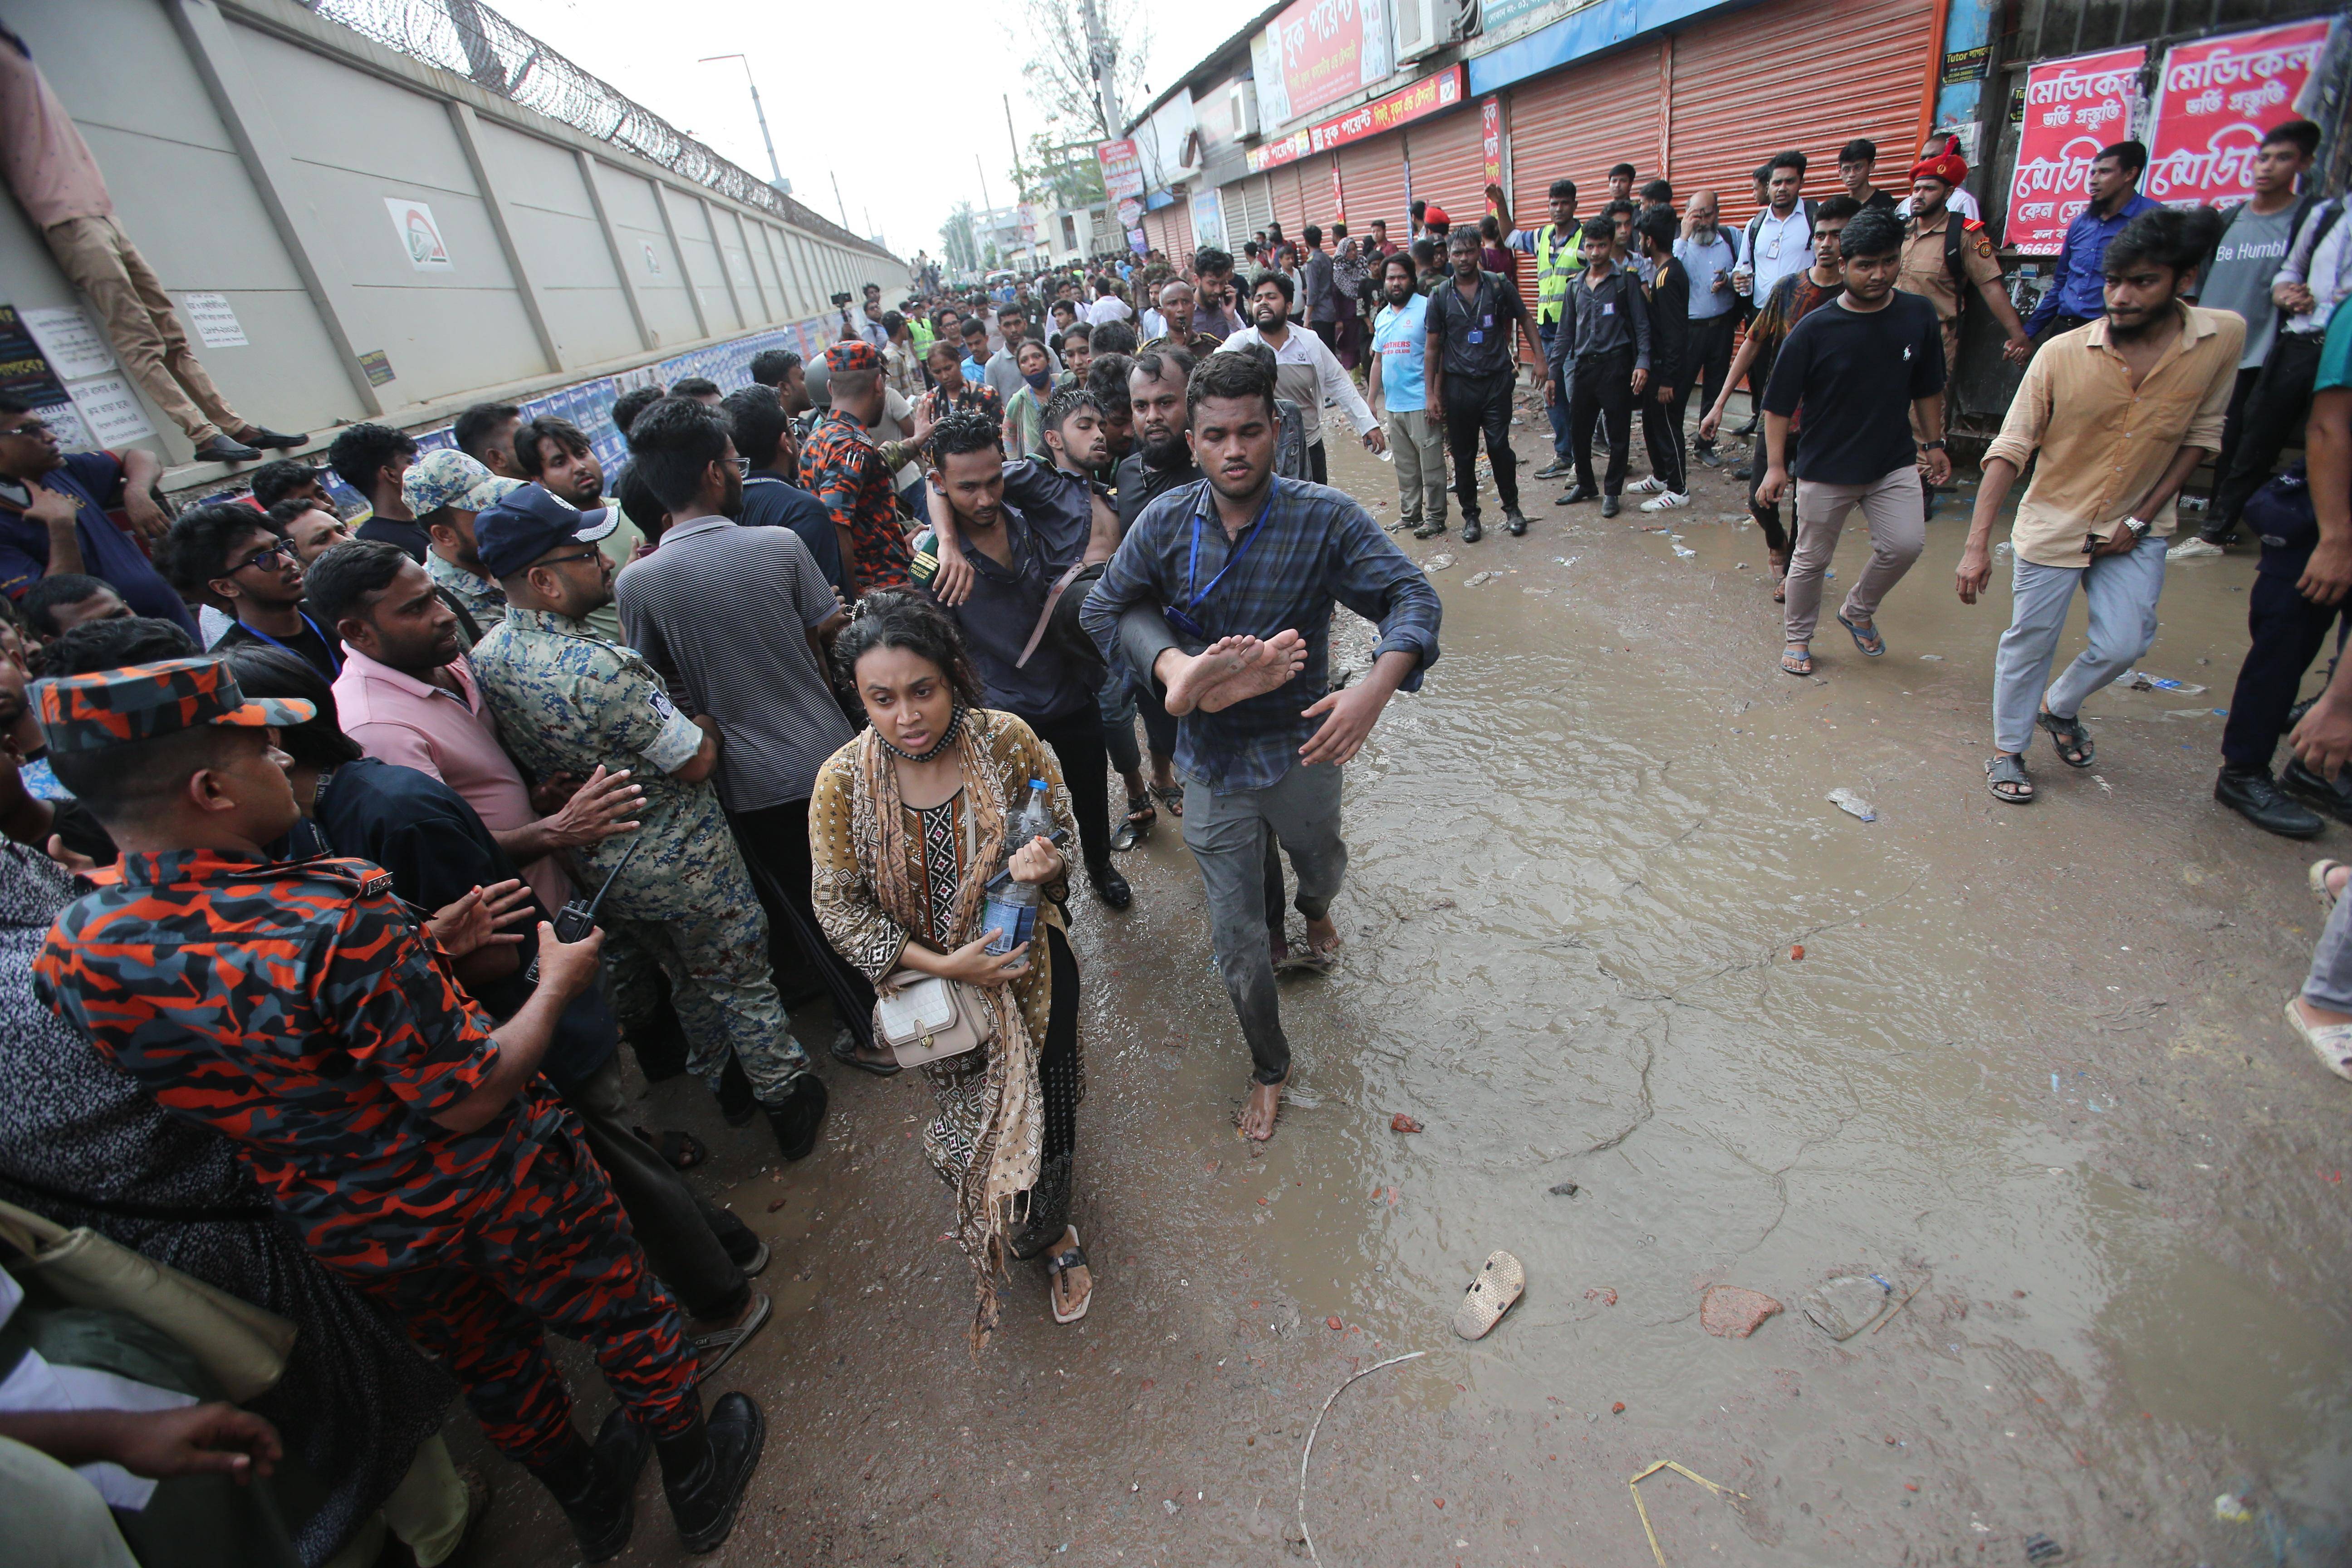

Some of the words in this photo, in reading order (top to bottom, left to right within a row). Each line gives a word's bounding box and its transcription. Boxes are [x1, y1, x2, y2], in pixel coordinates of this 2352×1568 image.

[1947, 53, 1968, 63] Tutor
[2167, 40, 2323, 93] মেডিকেল
[2185, 89, 2223, 114] ভর্তি
[2043, 104, 2071, 127] ভর্তি
[2074, 98, 2122, 131] প্রস্তুতি
[1323, 124, 1339, 147] বুক
[2018, 202, 2054, 222] কেন
[2058, 200, 2091, 224] সে
[2032, 229, 2053, 240] কল
[2015, 243, 2063, 255] 96667
[2216, 245, 2233, 261] Be
[2237, 240, 2287, 260] Humbl
[911, 568, 926, 580] COLLEGE
